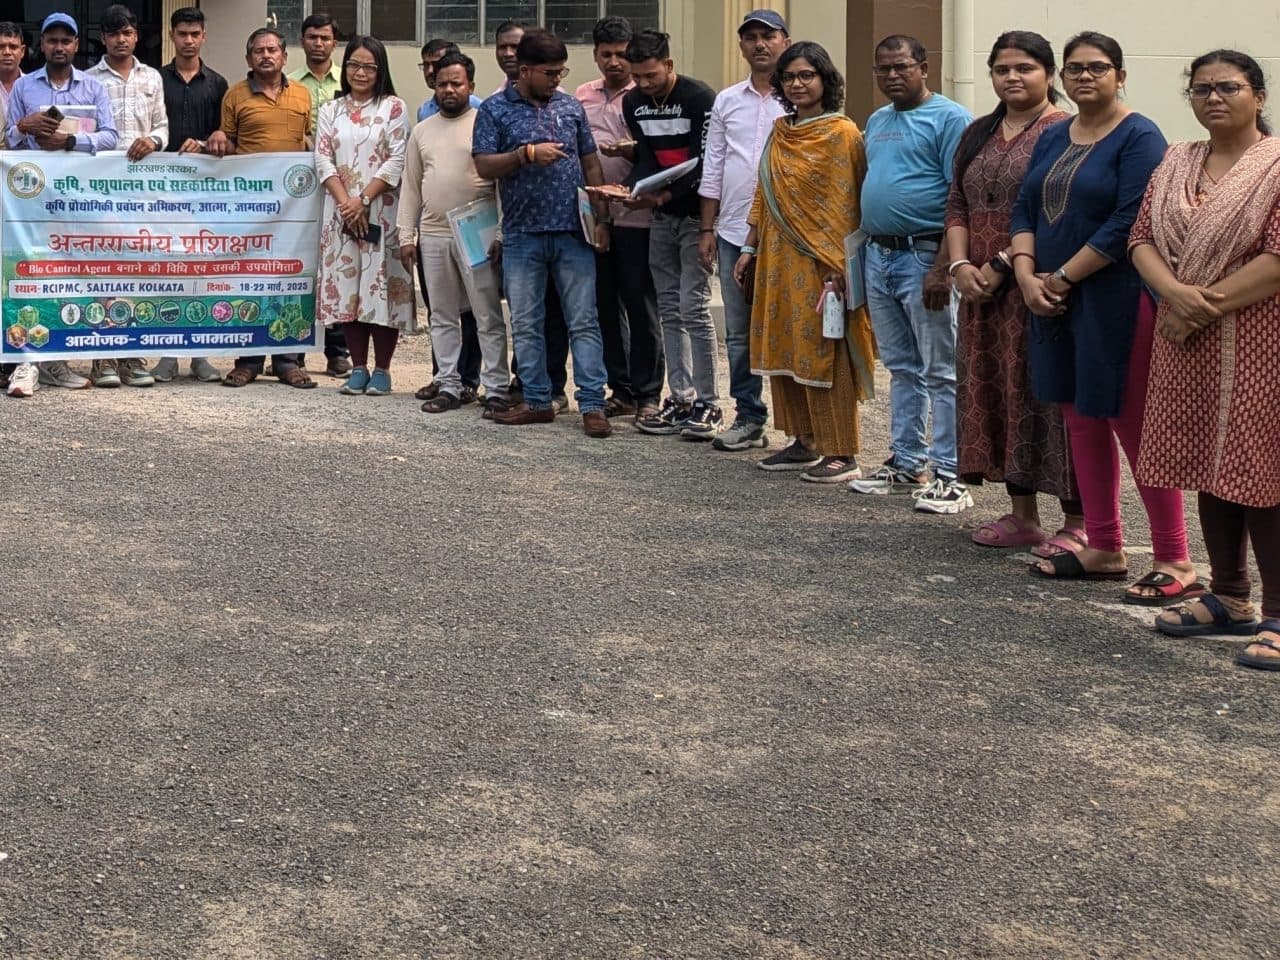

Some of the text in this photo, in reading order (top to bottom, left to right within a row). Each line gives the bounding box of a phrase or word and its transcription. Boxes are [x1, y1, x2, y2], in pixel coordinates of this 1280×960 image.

[127, 164, 198, 174] झारखण्ड सरकार
[53, 175, 84, 194] कृषि,
[89, 178, 144, 195] पशुपालन
[147, 175, 166, 191] एवं
[169, 176, 230, 191] सहकारिता
[233, 176, 273, 192] विभाग
[45, 199, 65, 214] कृषि
[116, 199, 144, 212] प्रबंधन
[147, 199, 195, 214] अभिकरण,
[199, 201, 231, 214] आत्मा,
[179, 228, 274, 255] प्रशिक्षण
[45, 263, 81, 274] Cantrol
[83, 263, 111, 276] Agent
[116, 262, 142, 273] बनाने
[148, 262, 161, 273] की
[167, 262, 188, 273] विधि
[194, 262, 207, 274] एवं
[213, 262, 240, 273] उसकी
[43, 283, 83, 294] RCIPMC,
[87, 282, 135, 292] SALTLAKE
[138, 282, 184, 292] KOLKATA
[240, 283, 265, 292] 18-22
[287, 282, 308, 291] 2025
[140, 333, 188, 346] आत्मा,
[191, 332, 254, 347] जामताड़ा
